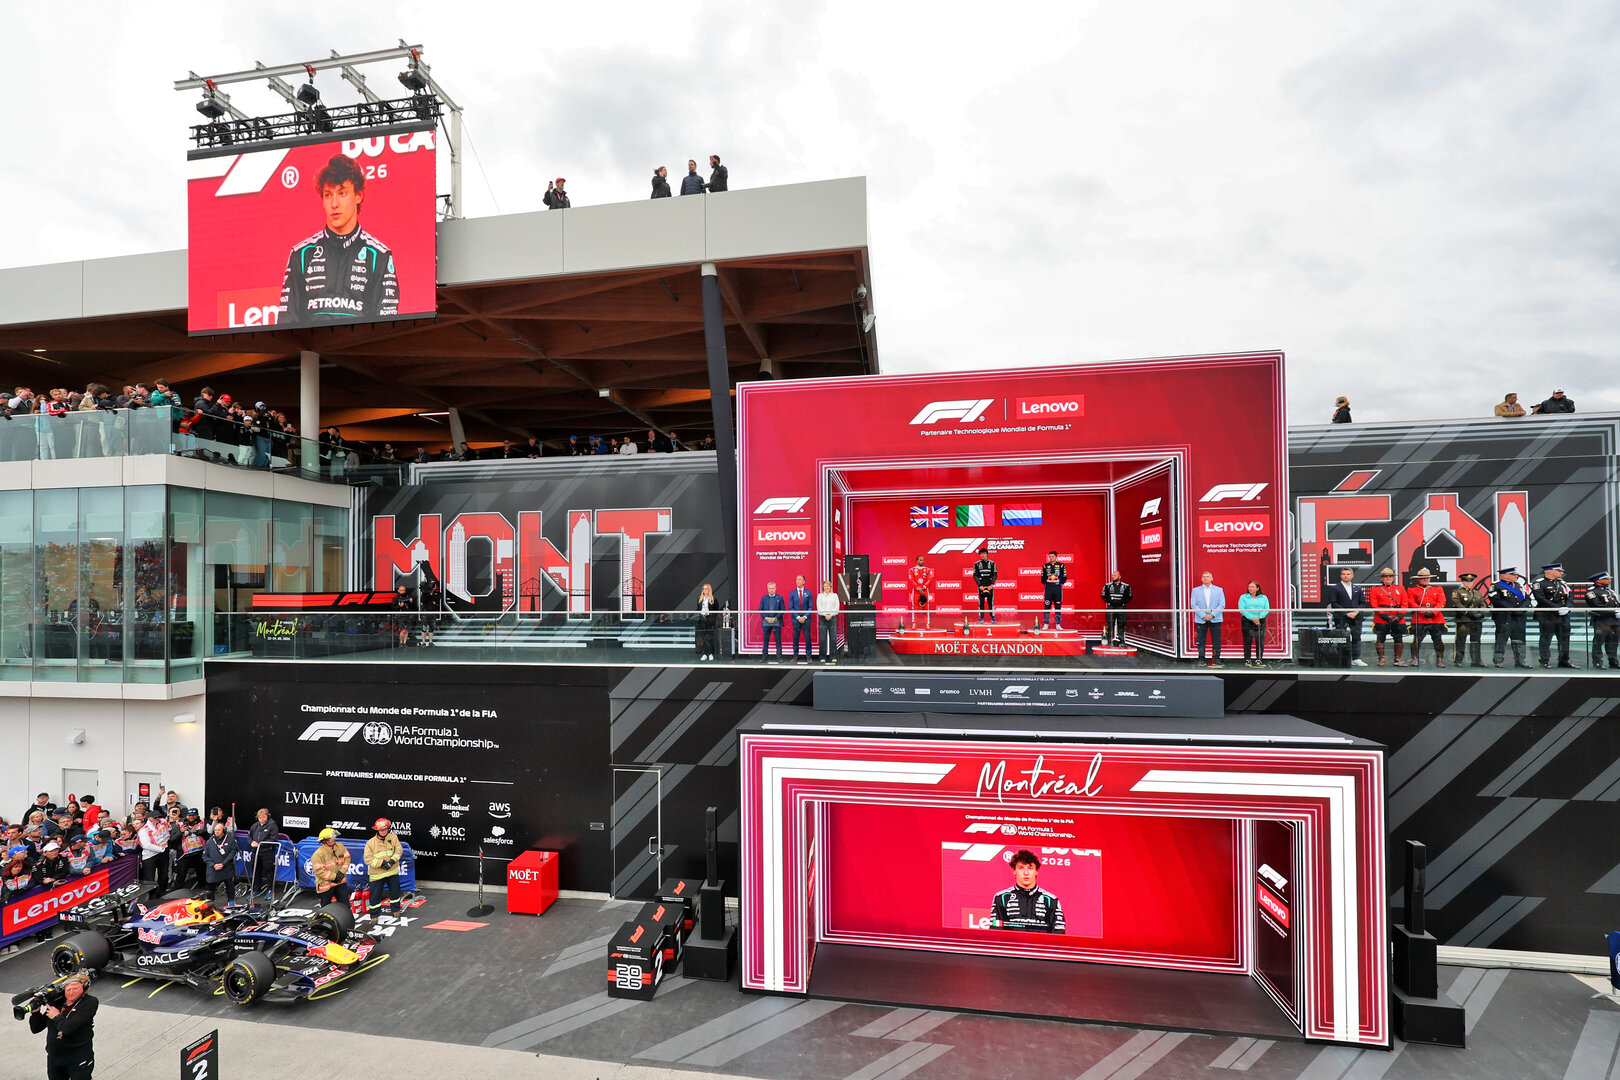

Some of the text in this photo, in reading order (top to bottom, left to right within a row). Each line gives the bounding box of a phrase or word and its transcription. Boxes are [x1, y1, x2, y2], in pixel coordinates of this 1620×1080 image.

[361, 164, 388, 180] 26
[307, 297, 364, 312] PETRONAS
[1021, 401, 1079, 415] Lenovo
[920, 428, 953, 436] Partenaire
[954, 427, 1000, 435] Technologique
[1205, 520, 1264, 532] Lenovo
[758, 529, 806, 541] Lenovo
[1141, 533, 1160, 545] Lenovo
[986, 628, 993, 636] 1
[934, 641, 1043, 654] MOËT & CHANDON
[300, 704, 497, 718] Championnat du Monde de Formula de la FIA
[394, 725, 459, 737] FIA Formula 1
[394, 736, 423, 745] World
[325, 770, 374, 779] PARTENAIRES
[374, 772, 413, 780] MONDIAUX
[424, 775, 459, 783] FORMULA
[976, 752, 1104, 804] Montréal
[285, 791, 325, 806] LVMH
[387, 799, 425, 809] aramco
[442, 803, 470, 811] Heineken
[488, 802, 511, 812] aws
[285, 817, 514, 846] Lenovo DHL ATAR MSC salesforce
[1041, 857, 1071, 866] 2026
[509, 868, 540, 881] MOËT
[12, 880, 101, 925] Lenovo
[1259, 889, 1287, 920] Lenovo
[968, 913, 990, 930] Le
[137, 949, 190, 966] ORACLE
[192, 1059, 208, 1080] 2
